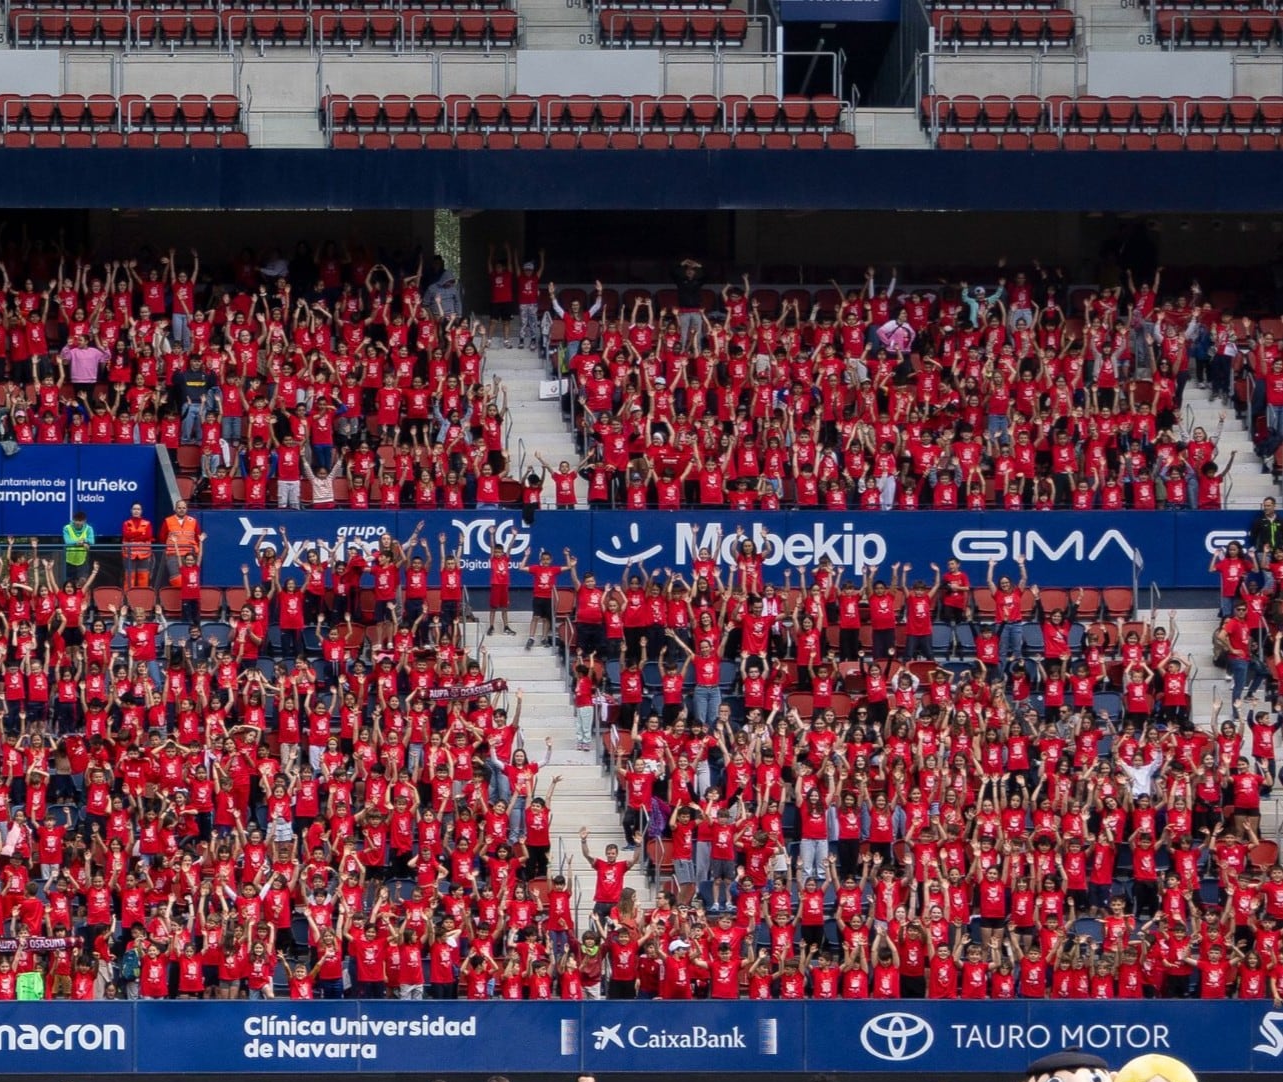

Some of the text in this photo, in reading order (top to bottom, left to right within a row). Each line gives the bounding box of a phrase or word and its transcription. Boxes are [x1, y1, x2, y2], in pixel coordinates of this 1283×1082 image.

[578, 33, 594, 45] 03
[1137, 34, 1153, 46] 03
[53, 477, 66, 486] de
[77, 478, 137, 492] Iruñeko
[77, 494, 105, 502] Udala
[337, 525, 387, 539] grupo
[244, 1015, 476, 1036] Clínica Universidad
[628, 1025, 746, 1049] CaixaBank
[951, 1024, 1170, 1049] TAURO MOTOR
[244, 1039, 377, 1059] de Navarra
